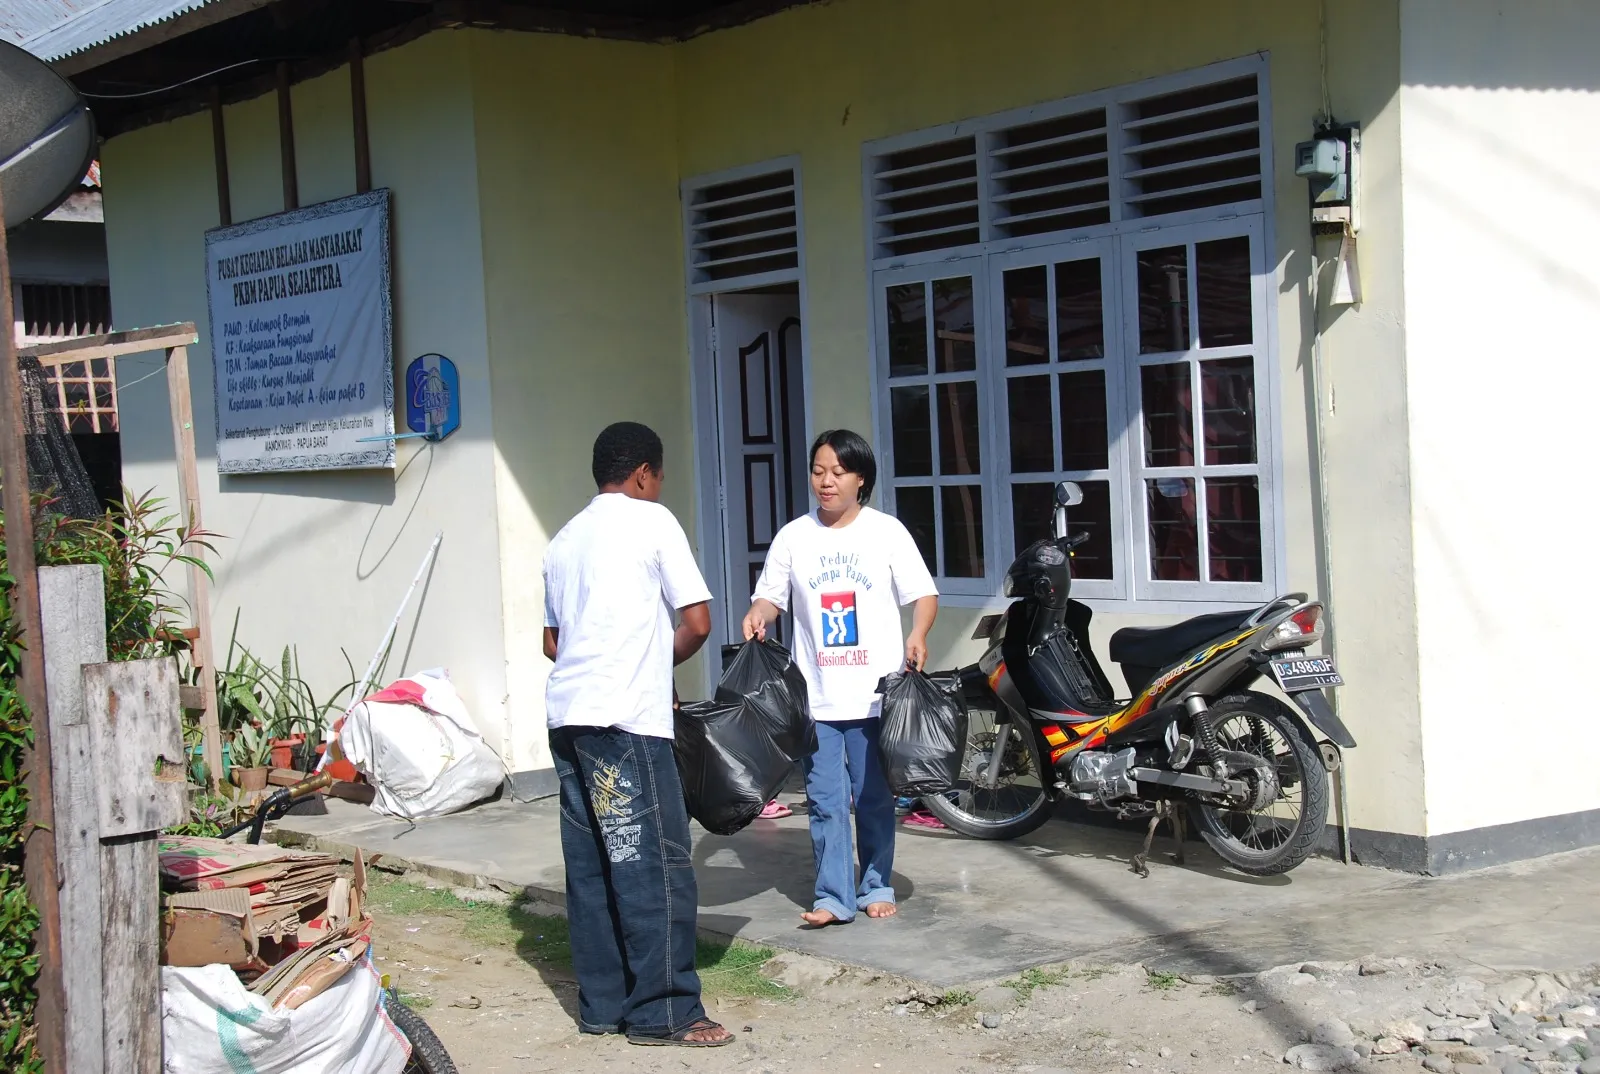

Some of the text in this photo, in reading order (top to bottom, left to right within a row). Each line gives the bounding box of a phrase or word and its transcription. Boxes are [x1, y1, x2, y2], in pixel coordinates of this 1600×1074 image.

[218, 228, 363, 280] PUSAT KEGIATAN BELAJAR MASYARAKAT
[233, 262, 342, 307] PKBM PAPUA SEJAHTERA
[225, 359, 242, 375] TBM
[308, 388, 315, 403] A
[358, 382, 365, 400] B
[819, 551, 860, 568] Peduli
[808, 564, 873, 591] Gempa Papua
